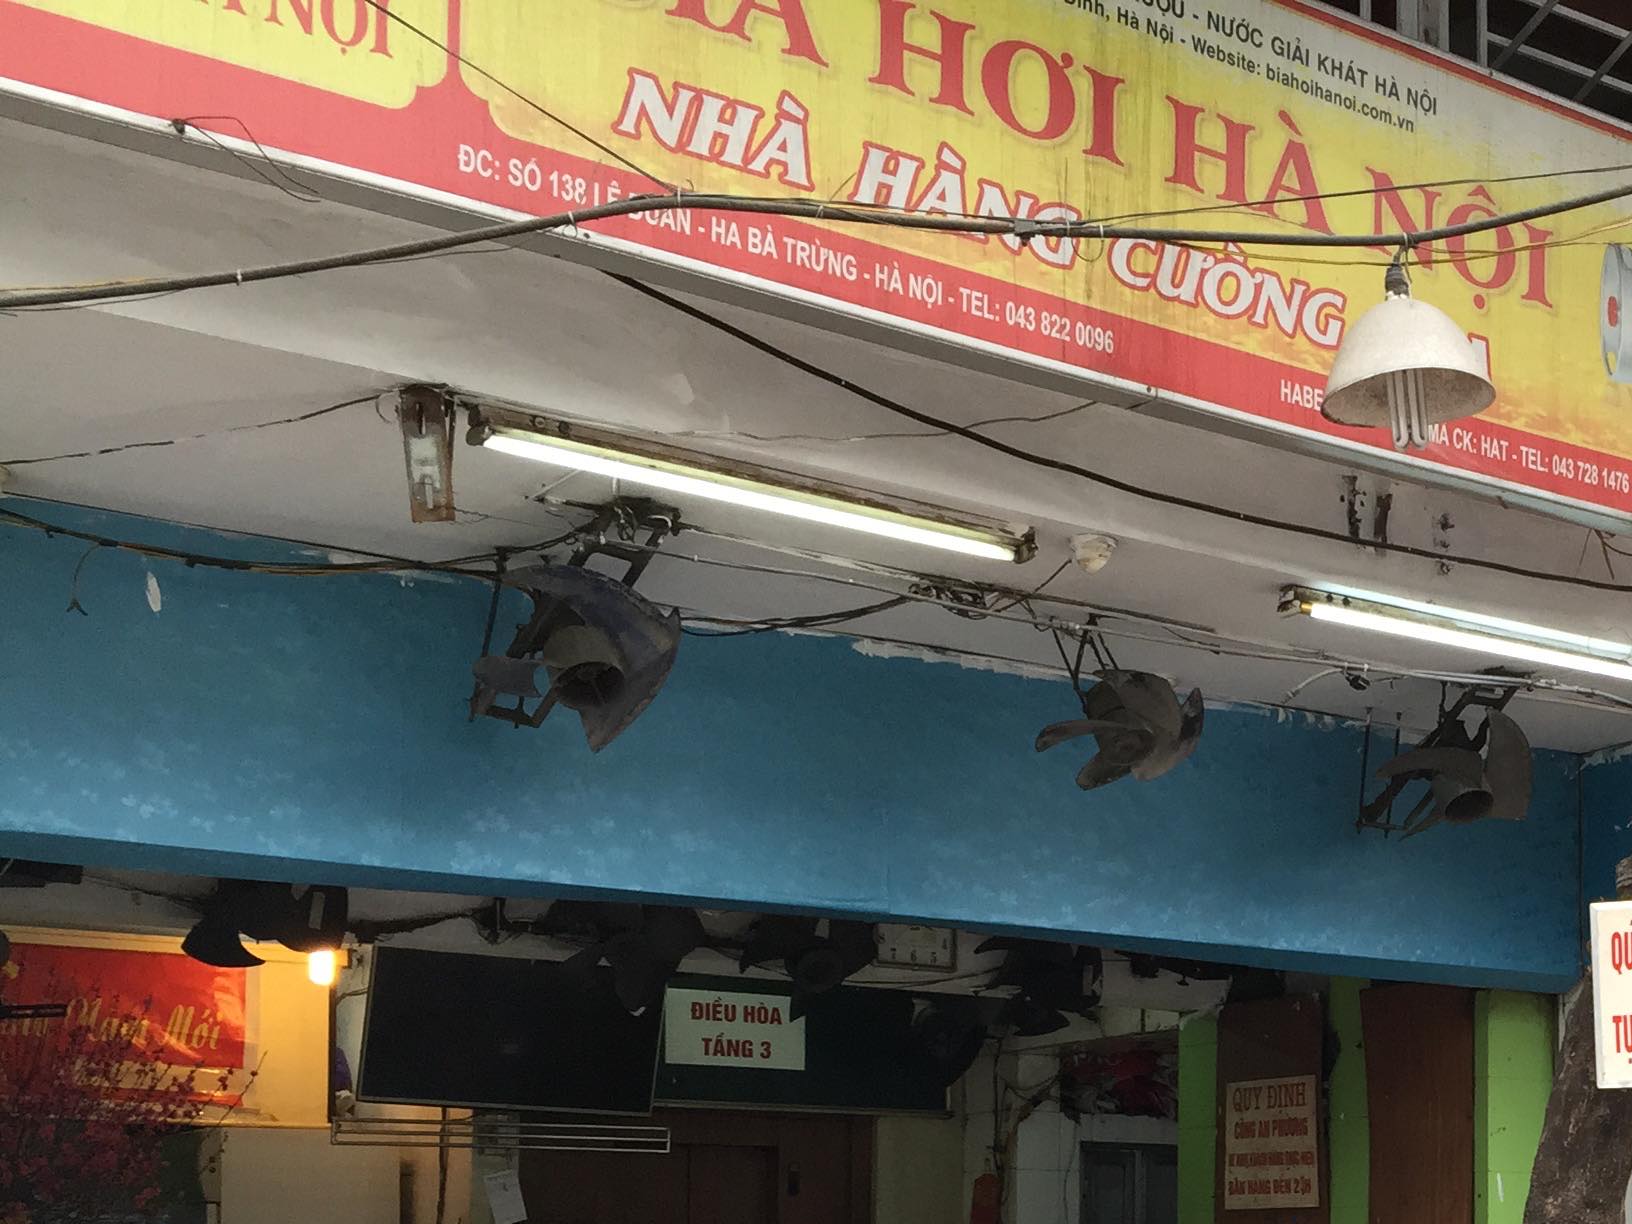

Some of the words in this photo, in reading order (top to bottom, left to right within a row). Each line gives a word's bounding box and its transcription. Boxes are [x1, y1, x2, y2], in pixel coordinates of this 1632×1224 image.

[1117, 6, 1139, 30] Hà
[1147, 18, 1174, 44] Nội
[1192, 36, 1261, 76] Website:
[1266, 64, 1414, 133] biahoihanoi.com.vn
[1207, 11, 1264, 48] NƯỚC
[1271, 36, 1310, 67] GIẢI
[1318, 54, 1368, 89] KHÁT
[1375, 75, 1400, 101] HÀ
[1407, 87, 1437, 116] NỘI
[612, 67, 814, 191] NHÀ
[850, 141, 1081, 269] HÀNG
[868, 0, 1125, 167] HƠI
[1164, 94, 1334, 237] HÀ
[1366, 166, 1553, 310] NỘI
[457, 144, 500, 180] ĐC:
[508, 157, 541, 191] SỐ
[549, 171, 586, 205] 138
[711, 216, 741, 249] HA
[748, 221, 778, 259] BÀ
[875, 262, 903, 295] HÀ
[909, 274, 943, 309] NỘI
[959, 287, 1000, 321] TEL:
[1005, 301, 1036, 331] 043
[1041, 311, 1071, 341] 822
[1075, 321, 1114, 353] 0096
[1453, 427, 1476, 453] CK:
[1481, 435, 1509, 461] HAT
[1520, 446, 1548, 472] TEL:
[1552, 455, 1574, 479] 043
[1578, 461, 1598, 486] 728
[1602, 468, 1629, 493] 1476
[691, 996, 736, 1022] ĐIỀU
[744, 1002, 782, 1025] HÒA
[760, 1041, 771, 1058] 3
